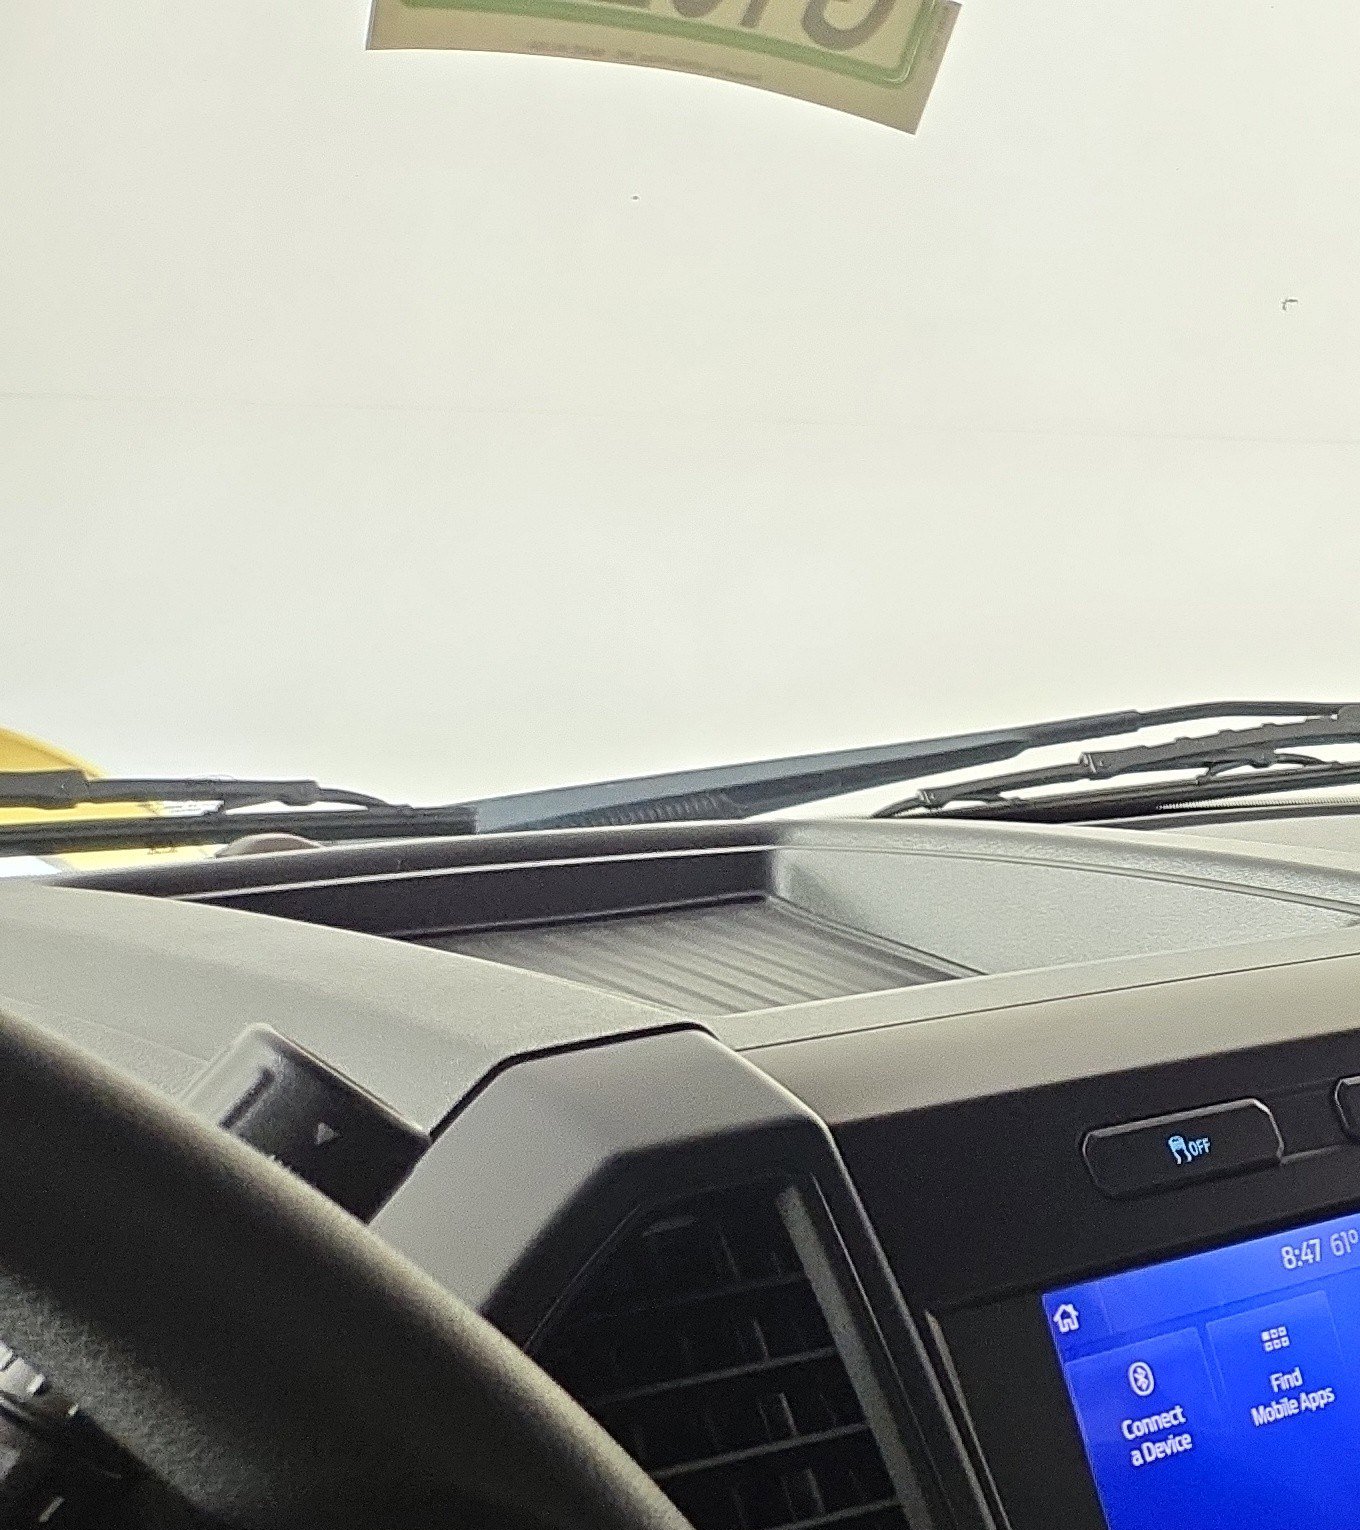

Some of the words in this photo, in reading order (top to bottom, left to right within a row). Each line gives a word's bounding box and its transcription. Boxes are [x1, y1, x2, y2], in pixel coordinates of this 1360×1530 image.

[1190, 1136, 1212, 1157] OFF
[1281, 1238, 1321, 1270] 8:47
[1270, 1366, 1303, 1392] Find
[1121, 1404, 1187, 1440] Connect
[1250, 1396, 1300, 1427] Mobile
[1300, 1386, 1336, 1412] Apps
[1130, 1448, 1144, 1467] a
[1141, 1432, 1193, 1463] Device
